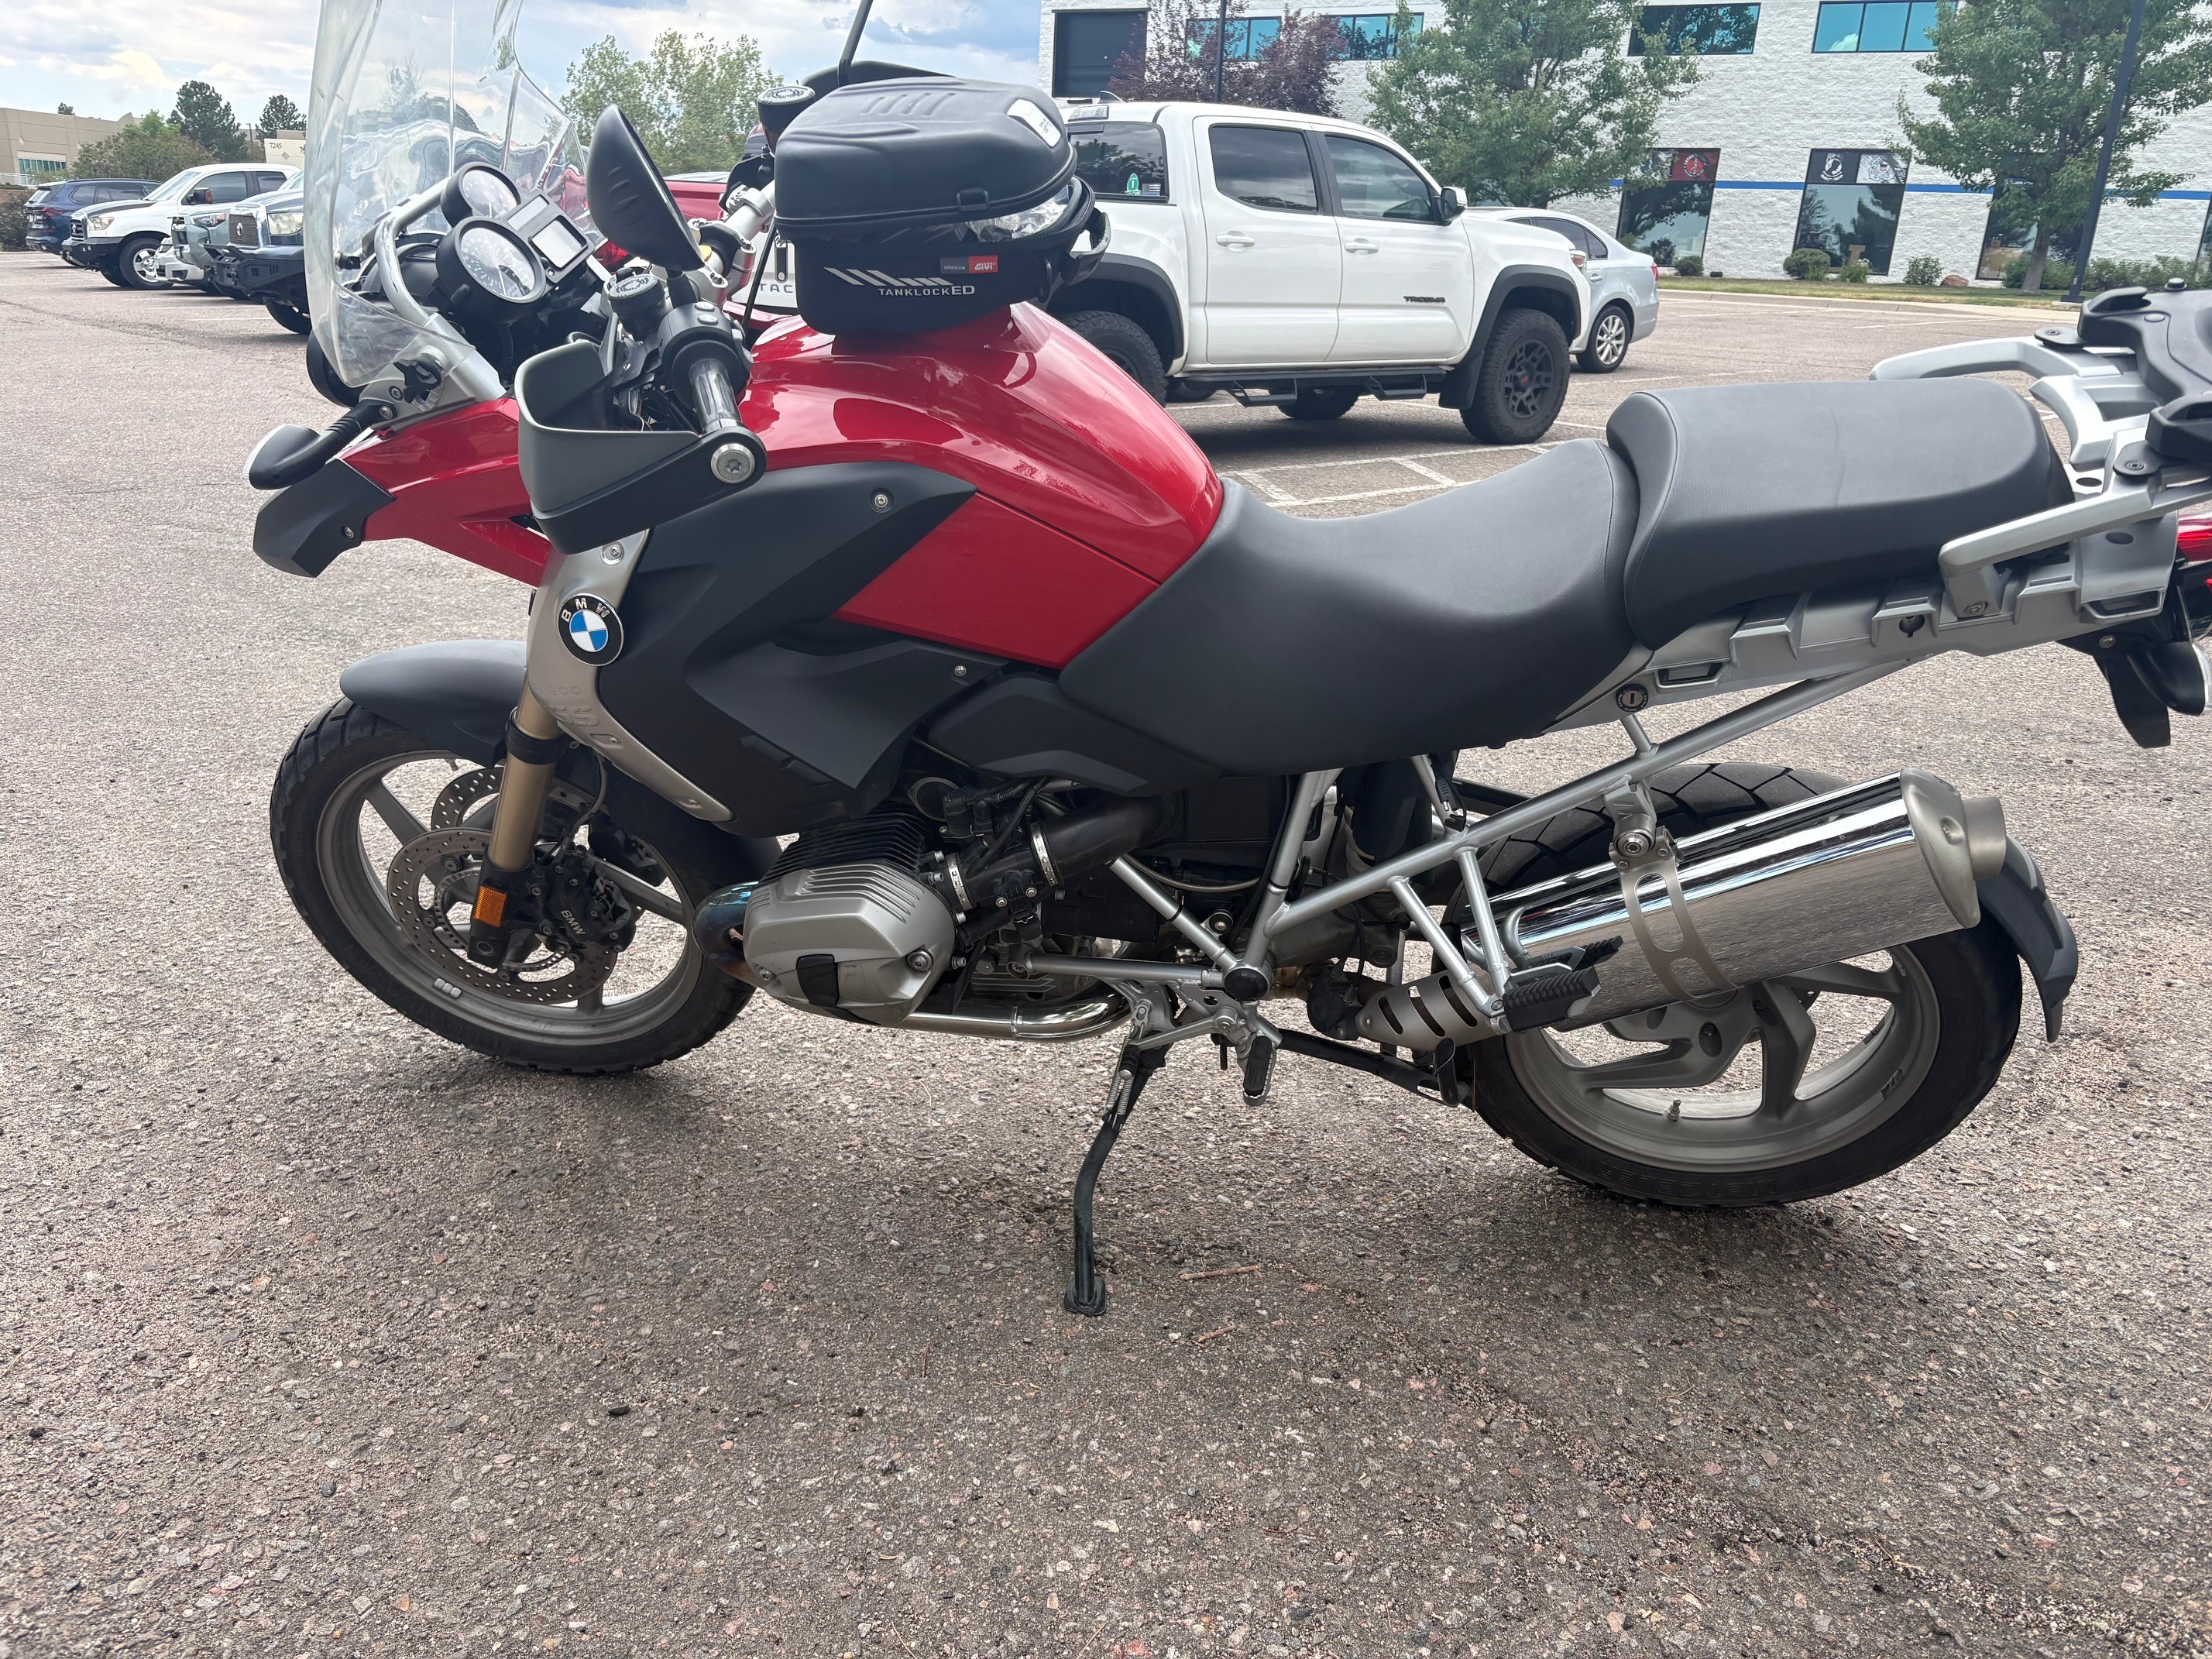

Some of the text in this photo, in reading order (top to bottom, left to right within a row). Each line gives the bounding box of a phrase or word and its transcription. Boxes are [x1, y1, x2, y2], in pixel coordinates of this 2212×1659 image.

[974, 262, 993, 271] GIVI
[878, 285, 975, 297] TANKLOCKED
[561, 597, 610, 623] BMW
[561, 909, 586, 934] BMW
